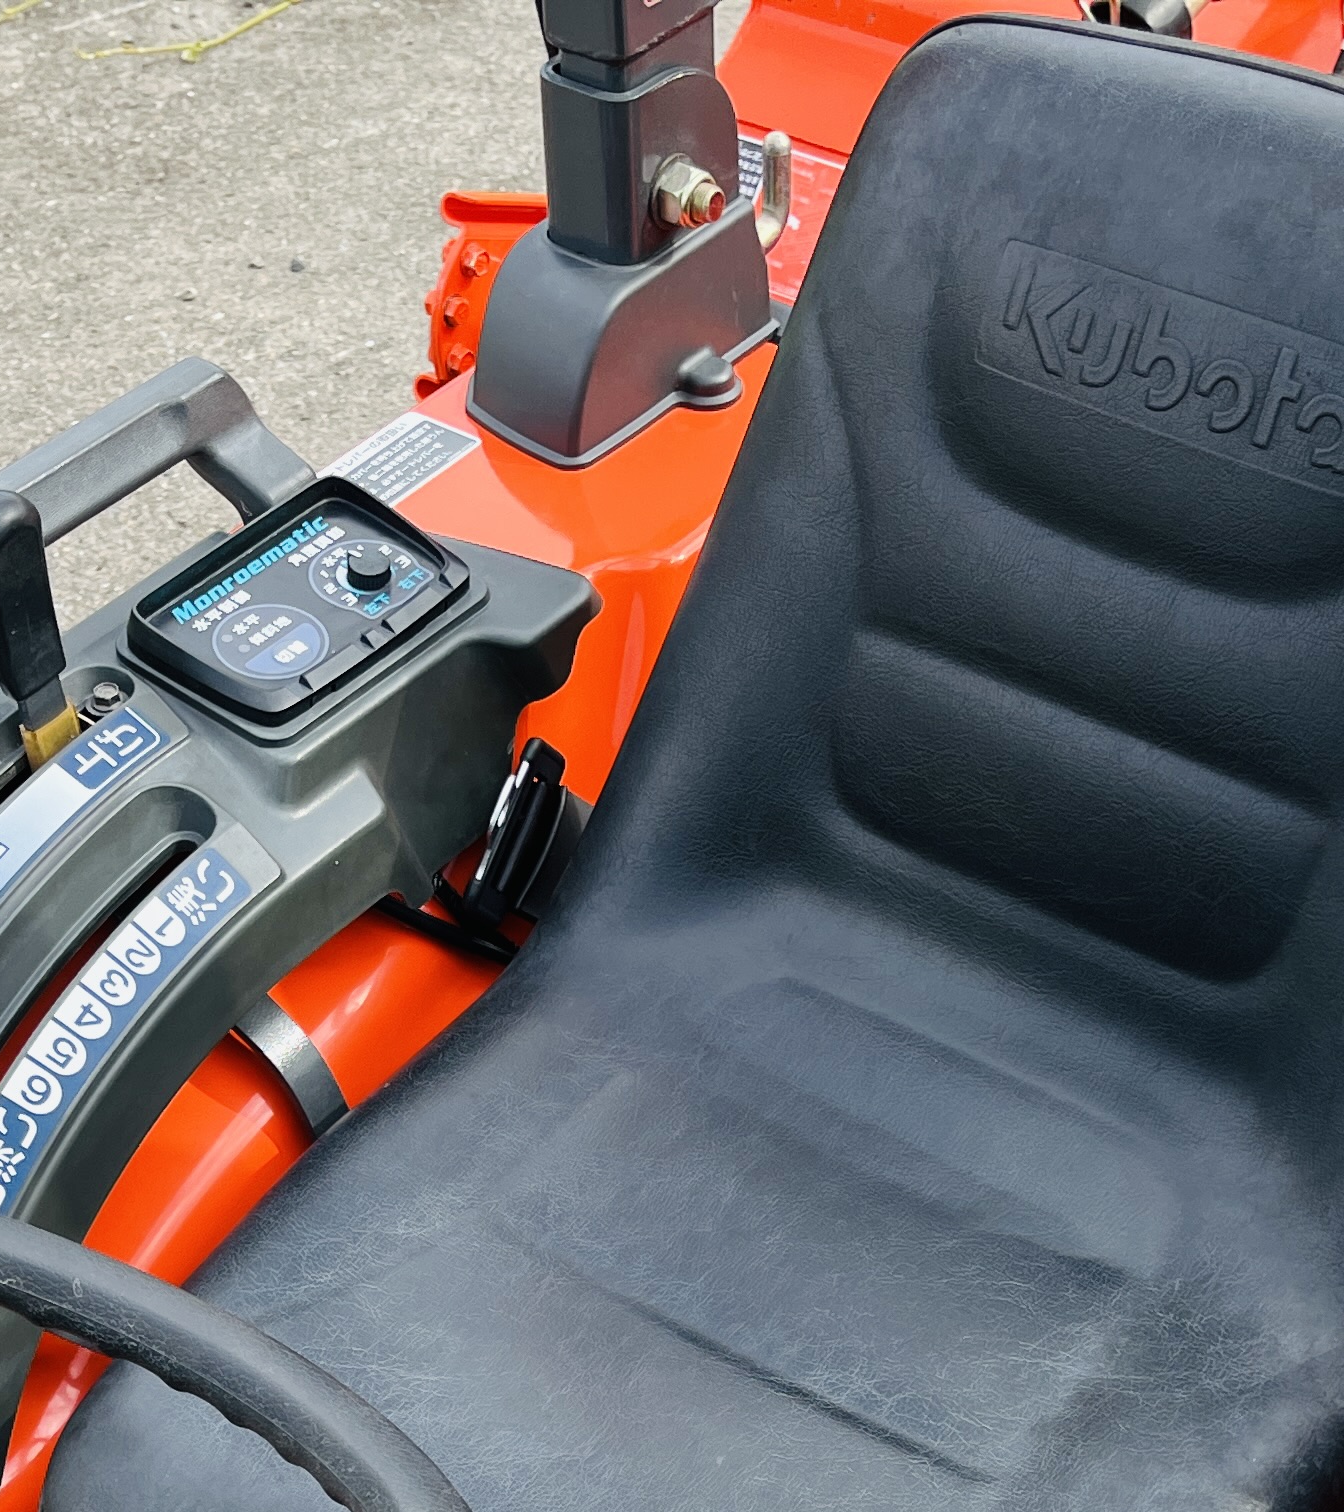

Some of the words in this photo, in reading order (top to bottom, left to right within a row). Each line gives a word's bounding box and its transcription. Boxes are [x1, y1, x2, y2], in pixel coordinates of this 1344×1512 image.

[171, 516, 329, 625] Monroematic
[73, 722, 139, 778] 上げ
[21, 1075, 51, 1105] 6
[45, 1037, 78, 1069] 5
[74, 1003, 104, 1027] 4
[99, 969, 129, 998] 3
[125, 939, 156, 968] 2
[156, 916, 174, 937] 1
[166, 858, 236, 926] 浅い
